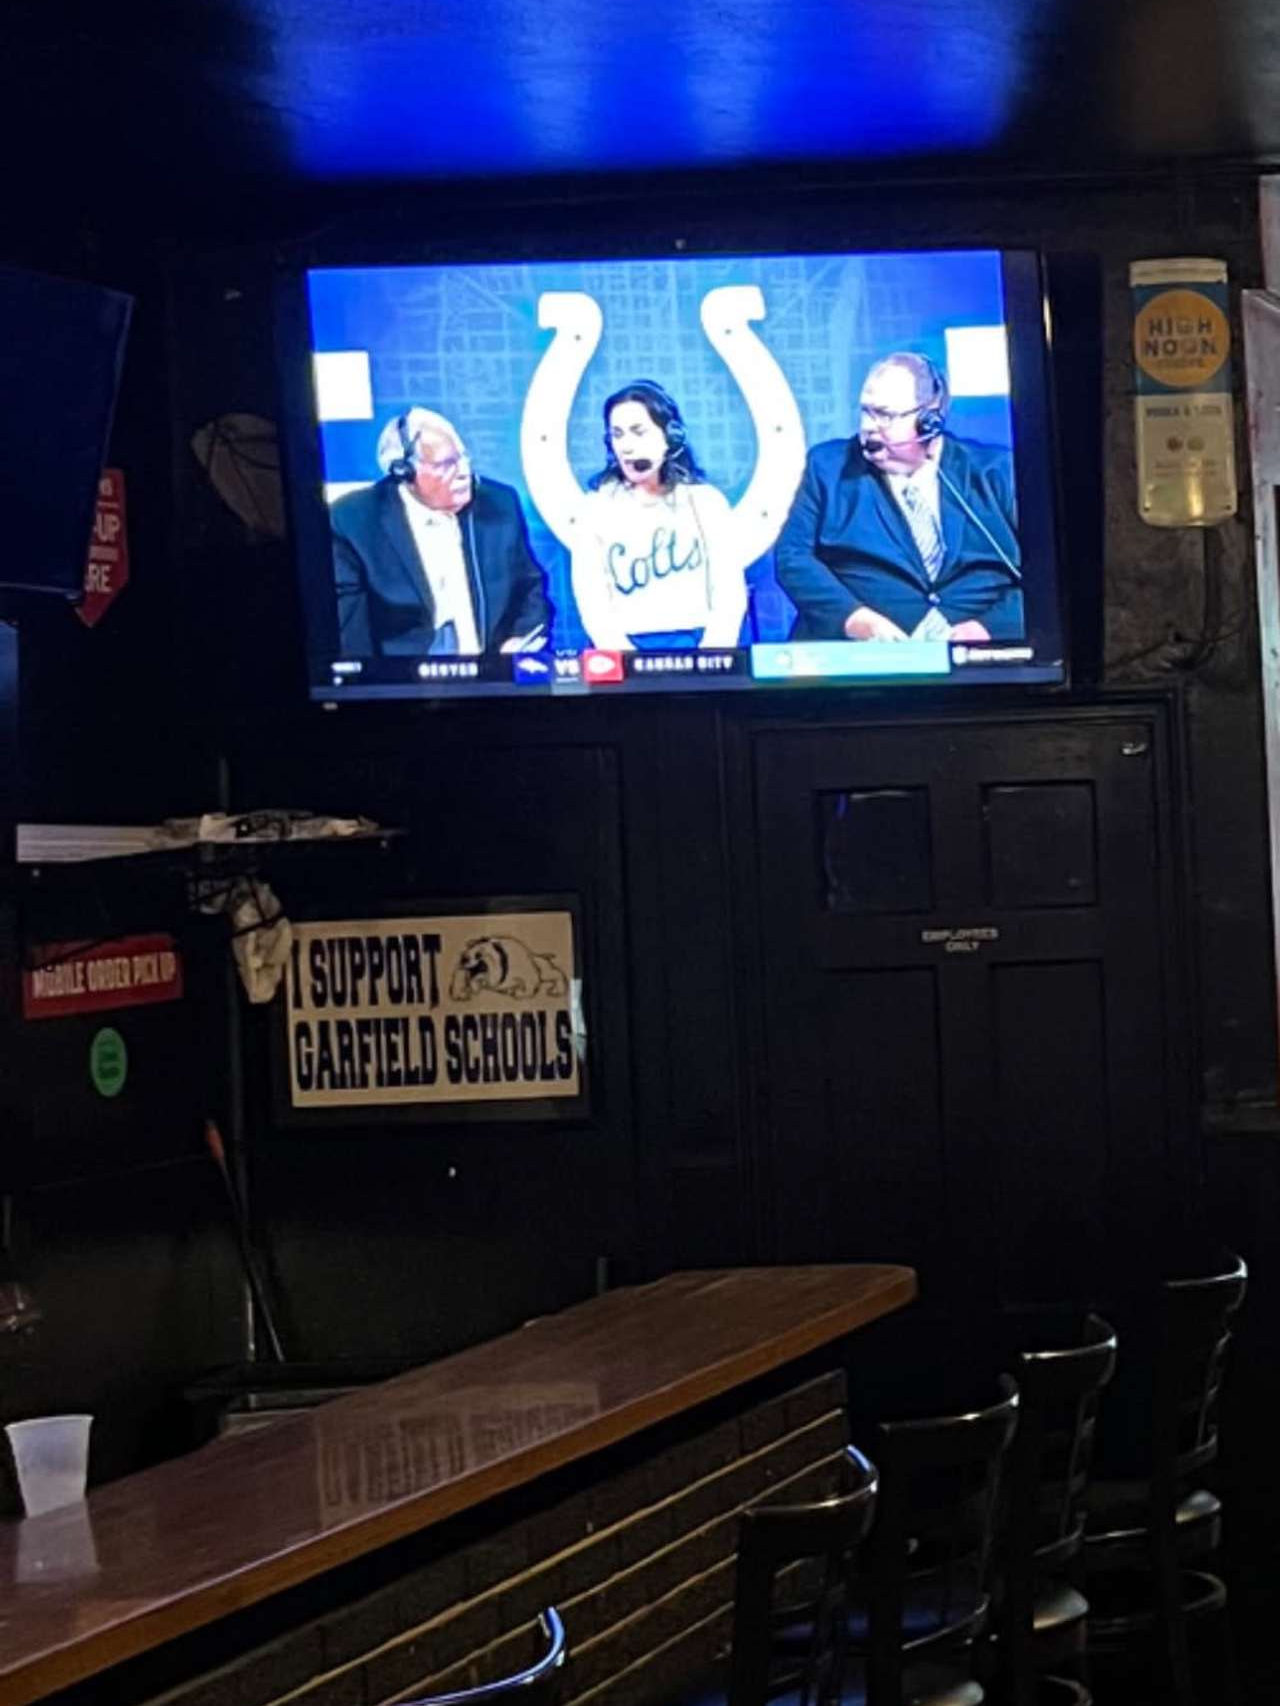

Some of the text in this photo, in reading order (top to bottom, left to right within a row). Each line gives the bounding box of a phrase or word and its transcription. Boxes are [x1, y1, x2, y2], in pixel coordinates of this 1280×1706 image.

[1144, 336, 1218, 357] NOON
[1149, 316, 1213, 337] HIGH
[607, 525, 703, 596] Colts
[32, 960, 87, 999] MOBILE
[86, 956, 131, 992] ORDER
[292, 933, 441, 1009] I SUPPORT
[295, 1009, 573, 1090] GARFIELD SCHOOLS
